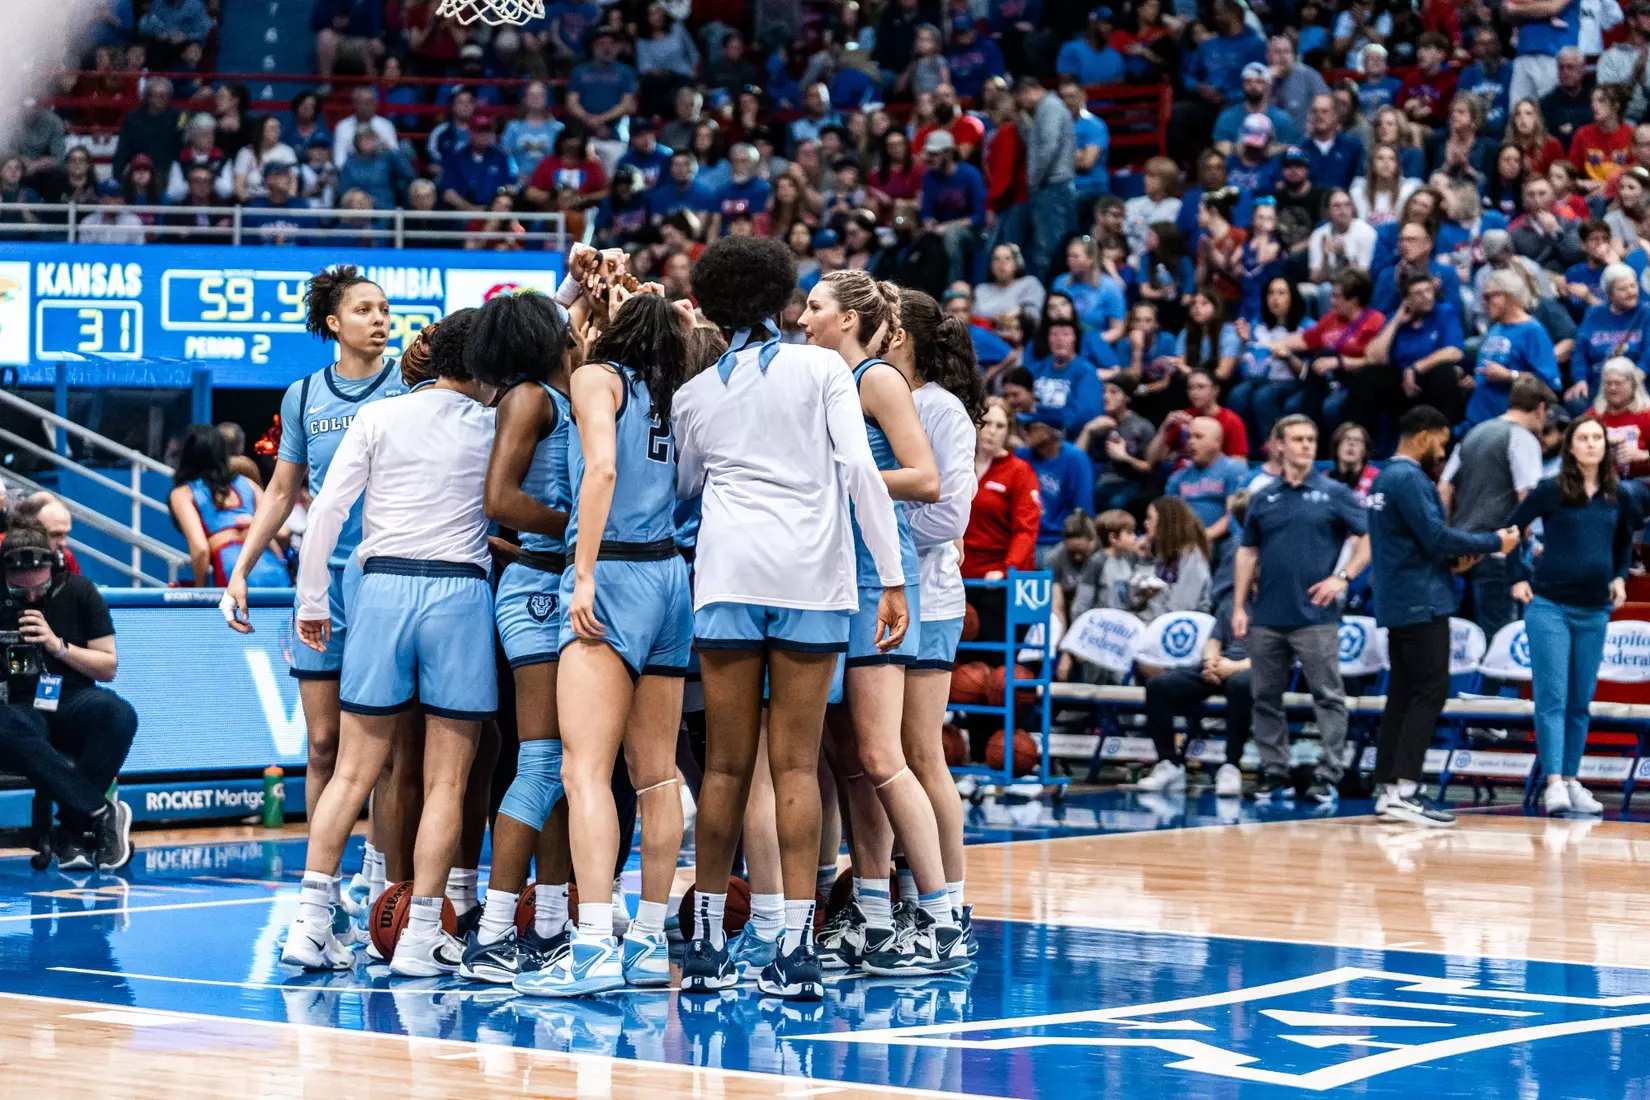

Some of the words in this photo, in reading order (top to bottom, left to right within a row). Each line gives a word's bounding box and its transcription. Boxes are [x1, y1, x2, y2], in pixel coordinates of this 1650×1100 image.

[36, 261, 142, 298] KANSAS
[77, 308, 130, 352] 31
[184, 336, 245, 359] PERIOD
[251, 333, 271, 364] 2
[1015, 578, 1051, 610] KU
[146, 790, 214, 811] ROCKET
[380, 880, 411, 928] Wilson
